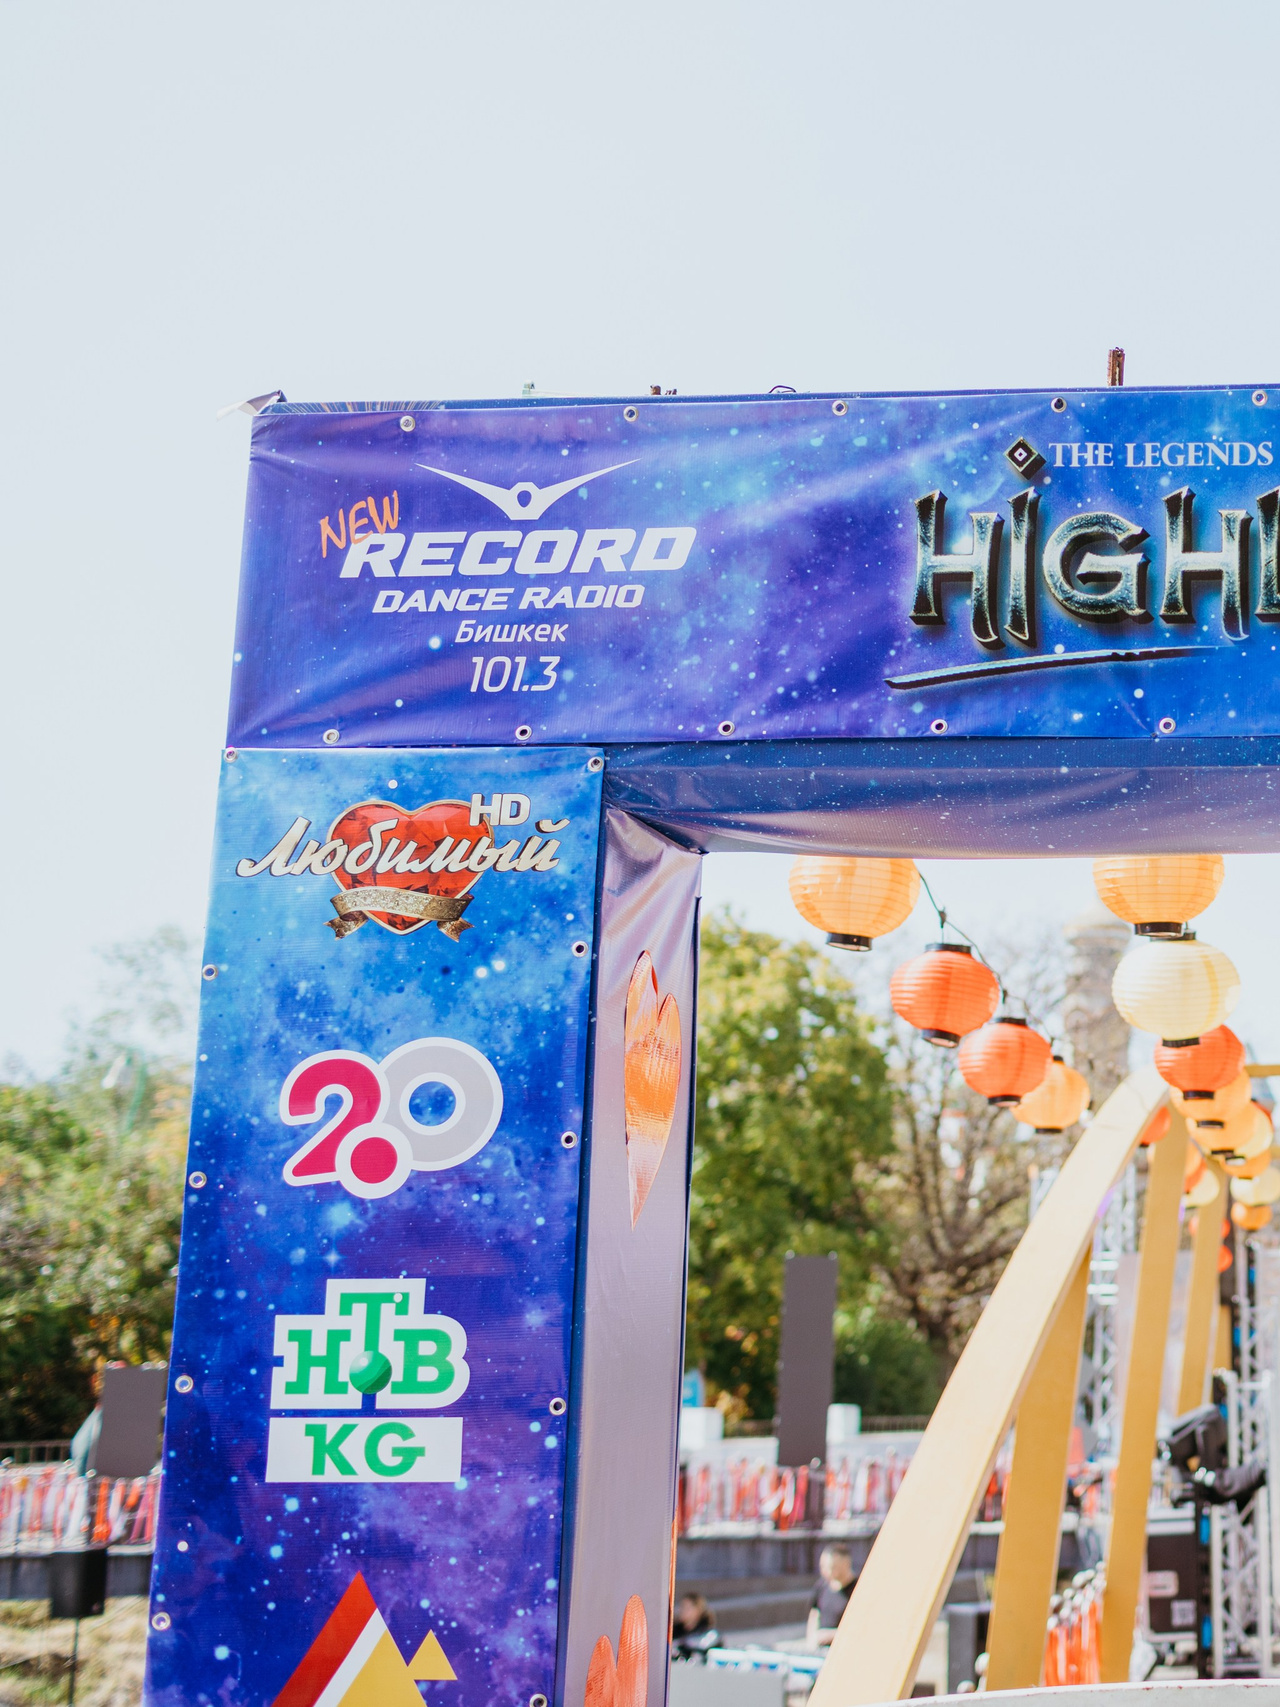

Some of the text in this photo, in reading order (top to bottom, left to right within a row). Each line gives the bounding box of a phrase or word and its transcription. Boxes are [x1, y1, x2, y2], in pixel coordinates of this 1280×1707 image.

[1049, 442, 1114, 467] THE
[1125, 441, 1274, 467] LEGENDS
[320, 490, 400, 558] NEW
[339, 527, 697, 579] RECORD
[372, 584, 645, 613] DANCE RADIO
[454, 621, 569, 643] Бишкек
[470, 656, 560, 693] 101.3
[469, 793, 530, 826] HD
[236, 816, 571, 877] Любимый
[284, 1292, 456, 1395] НТВ
[305, 1421, 426, 1477] KG
